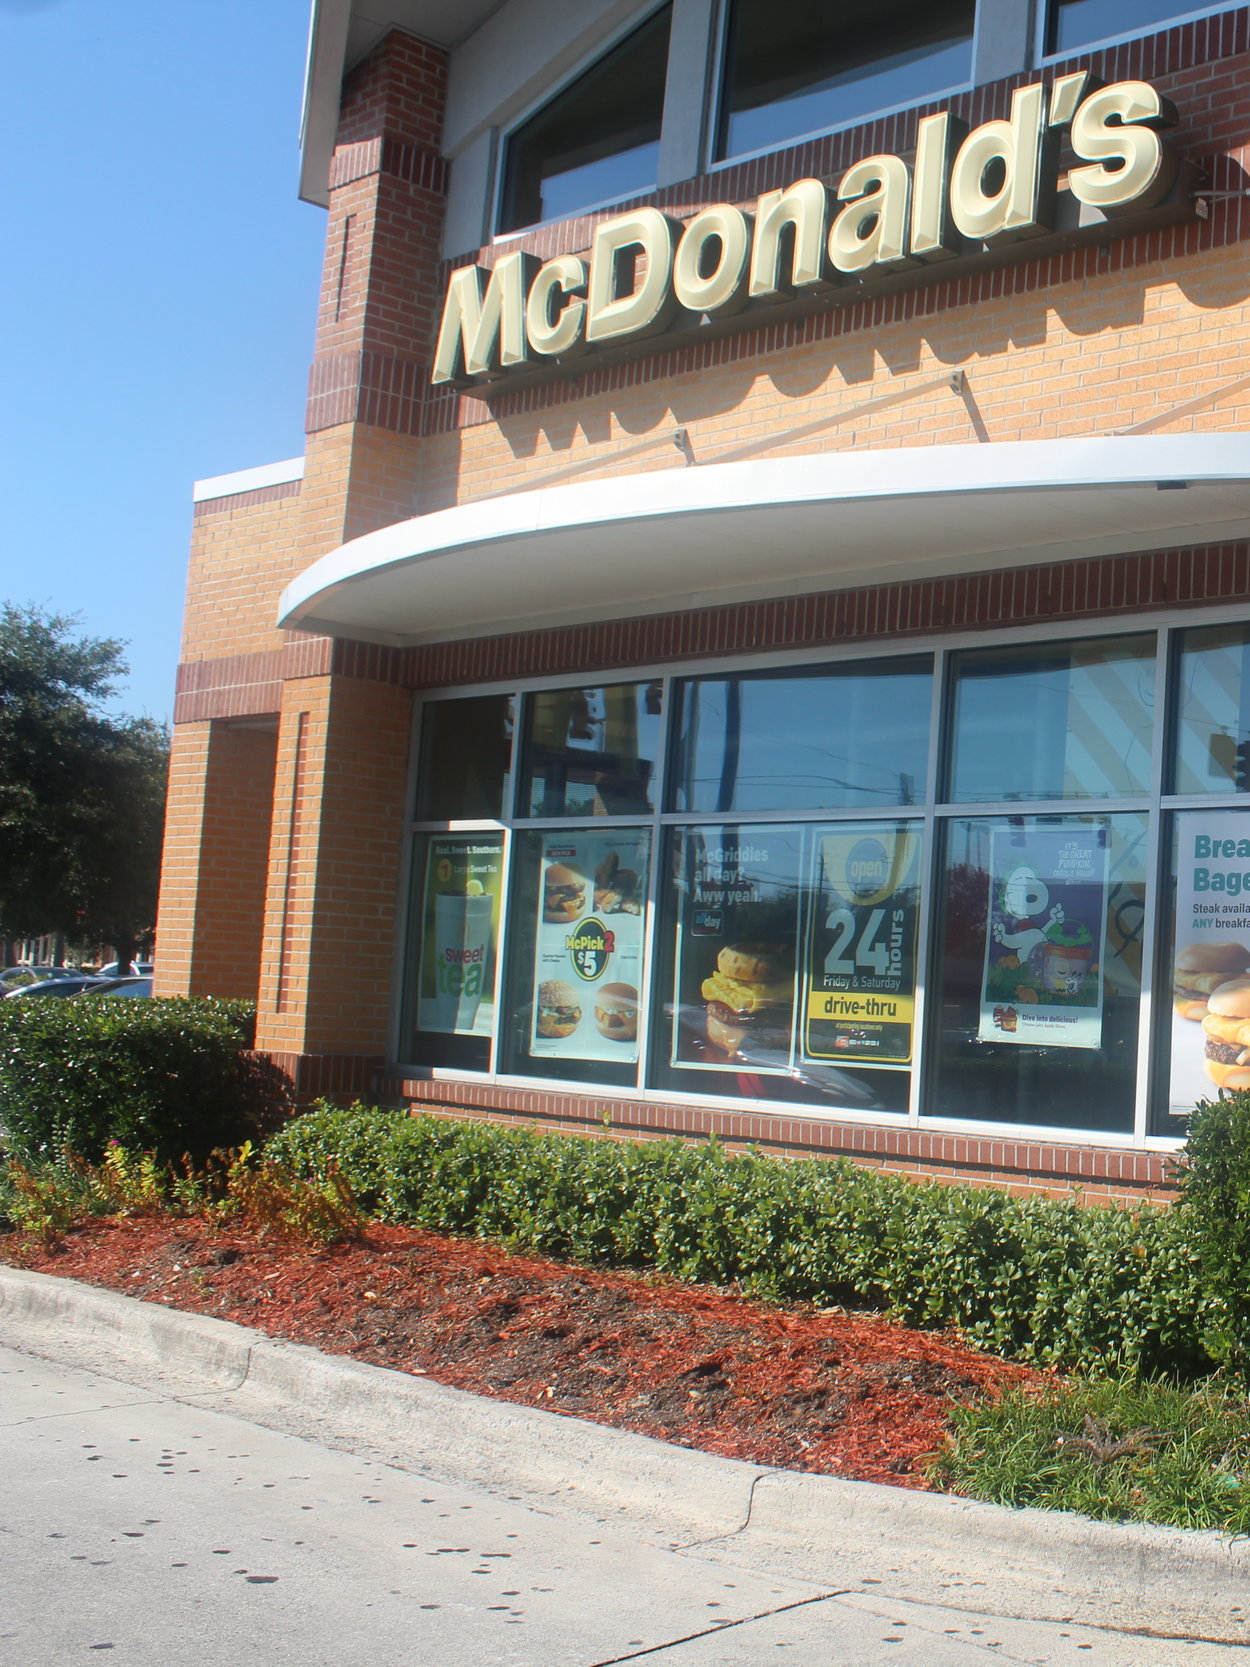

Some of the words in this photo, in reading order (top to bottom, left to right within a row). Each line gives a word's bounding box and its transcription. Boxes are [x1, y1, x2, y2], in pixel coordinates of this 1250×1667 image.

[431, 70, 1163, 385] McDonald's
[695, 846, 769, 863] McGriddles
[1070, 849, 1092, 859] GREAT
[470, 865, 487, 873] Sweet
[851, 860, 883, 882] open
[693, 887, 725, 904] Aww
[727, 887, 763, 906] yeah.
[1192, 903, 1221, 914] Steak
[703, 915, 721, 929] day
[1192, 918, 1214, 929] ANY
[565, 934, 604, 951] McPick
[603, 930, 615, 953] 2
[824, 908, 890, 976] 24
[886, 909, 905, 976] hours
[445, 944, 485, 964] sweet
[577, 951, 598, 977] $5
[438, 953, 483, 998] tea
[823, 974, 850, 990] Friday
[852, 975, 860, 987] &
[861, 975, 901, 991] Saturday
[824, 996, 897, 1017] drive-thru
[1036, 1014, 1048, 1022] into
[1048, 1015, 1079, 1024] delicious!
